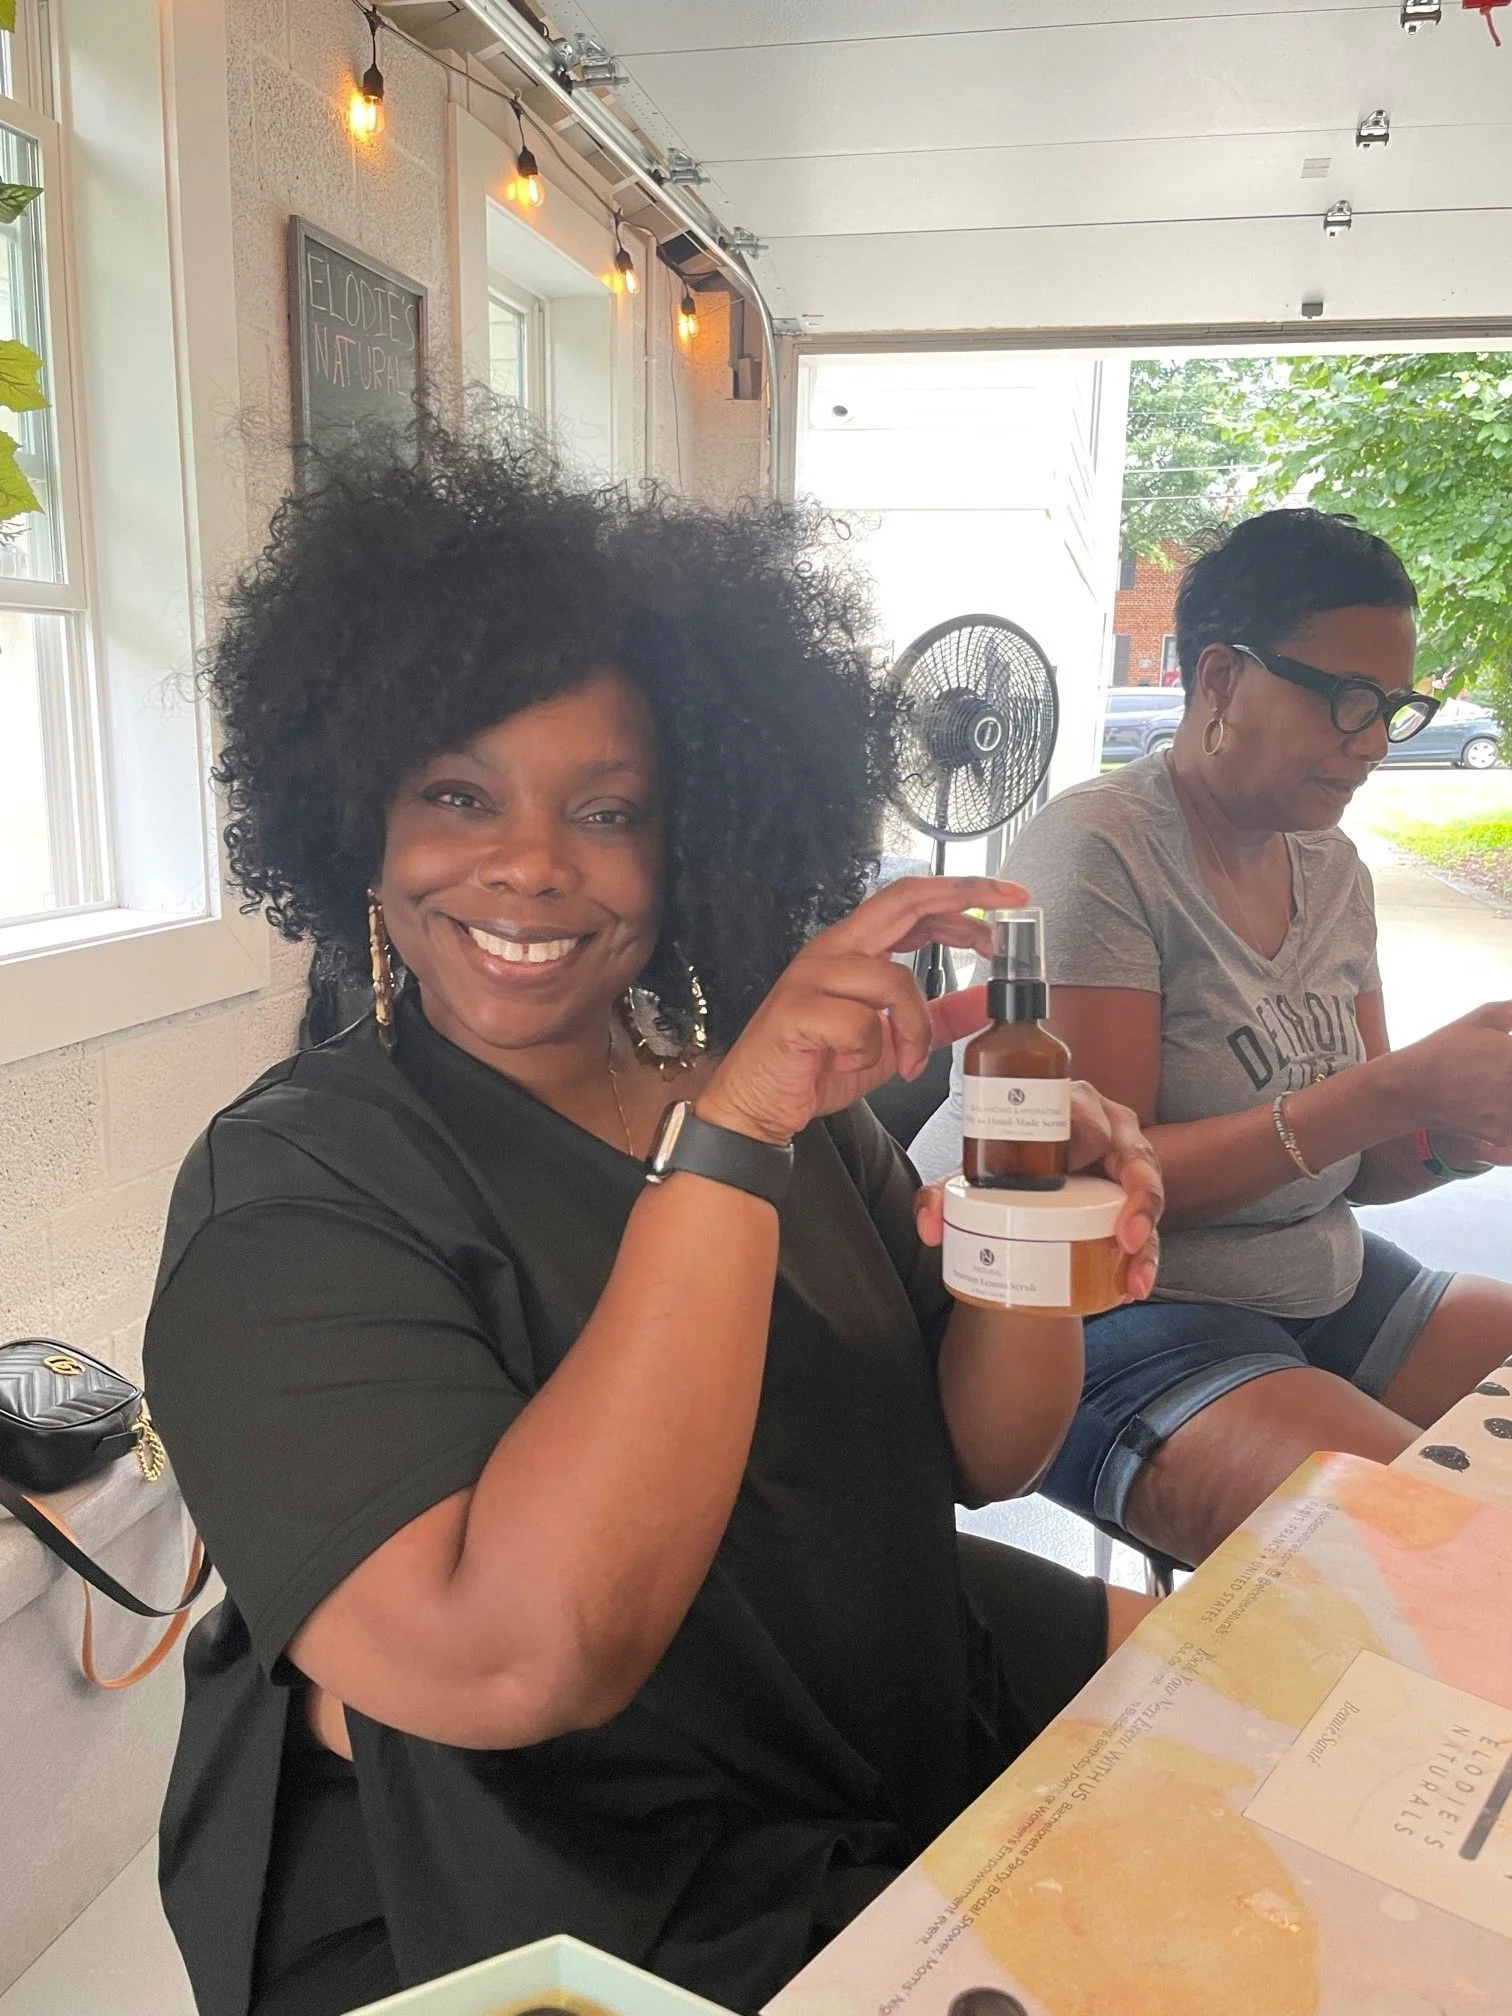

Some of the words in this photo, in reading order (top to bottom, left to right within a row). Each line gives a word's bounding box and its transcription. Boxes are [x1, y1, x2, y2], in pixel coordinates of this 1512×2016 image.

[307, 253, 416, 351] ELODIE'S
[313, 322, 416, 396] NATURAL
[1230, 1562, 1259, 1591] UNITED
[1201, 1590, 1233, 1624] STATES
[1163, 1670, 1192, 1697] Your
[1118, 1717, 1151, 1749] Event
[1073, 1739, 1106, 1772] Birthday
[1087, 1746, 1123, 1784] WITH
[1071, 1779, 1093, 1802] US
[1393, 1725, 1471, 1836] NATURALS
[1423, 1736, 1499, 1850] ELODIE'S
[1008, 1803, 1048, 1846] Women's
[1020, 1801, 1071, 1858] Bachelorette
[945, 1844, 1011, 1917] Empowerment
[993, 1856, 1023, 1886] Party,
[970, 1883, 999, 1916] Bridal
[915, 1913, 947, 1948] event.
[932, 1913, 973, 1957] Shower,
